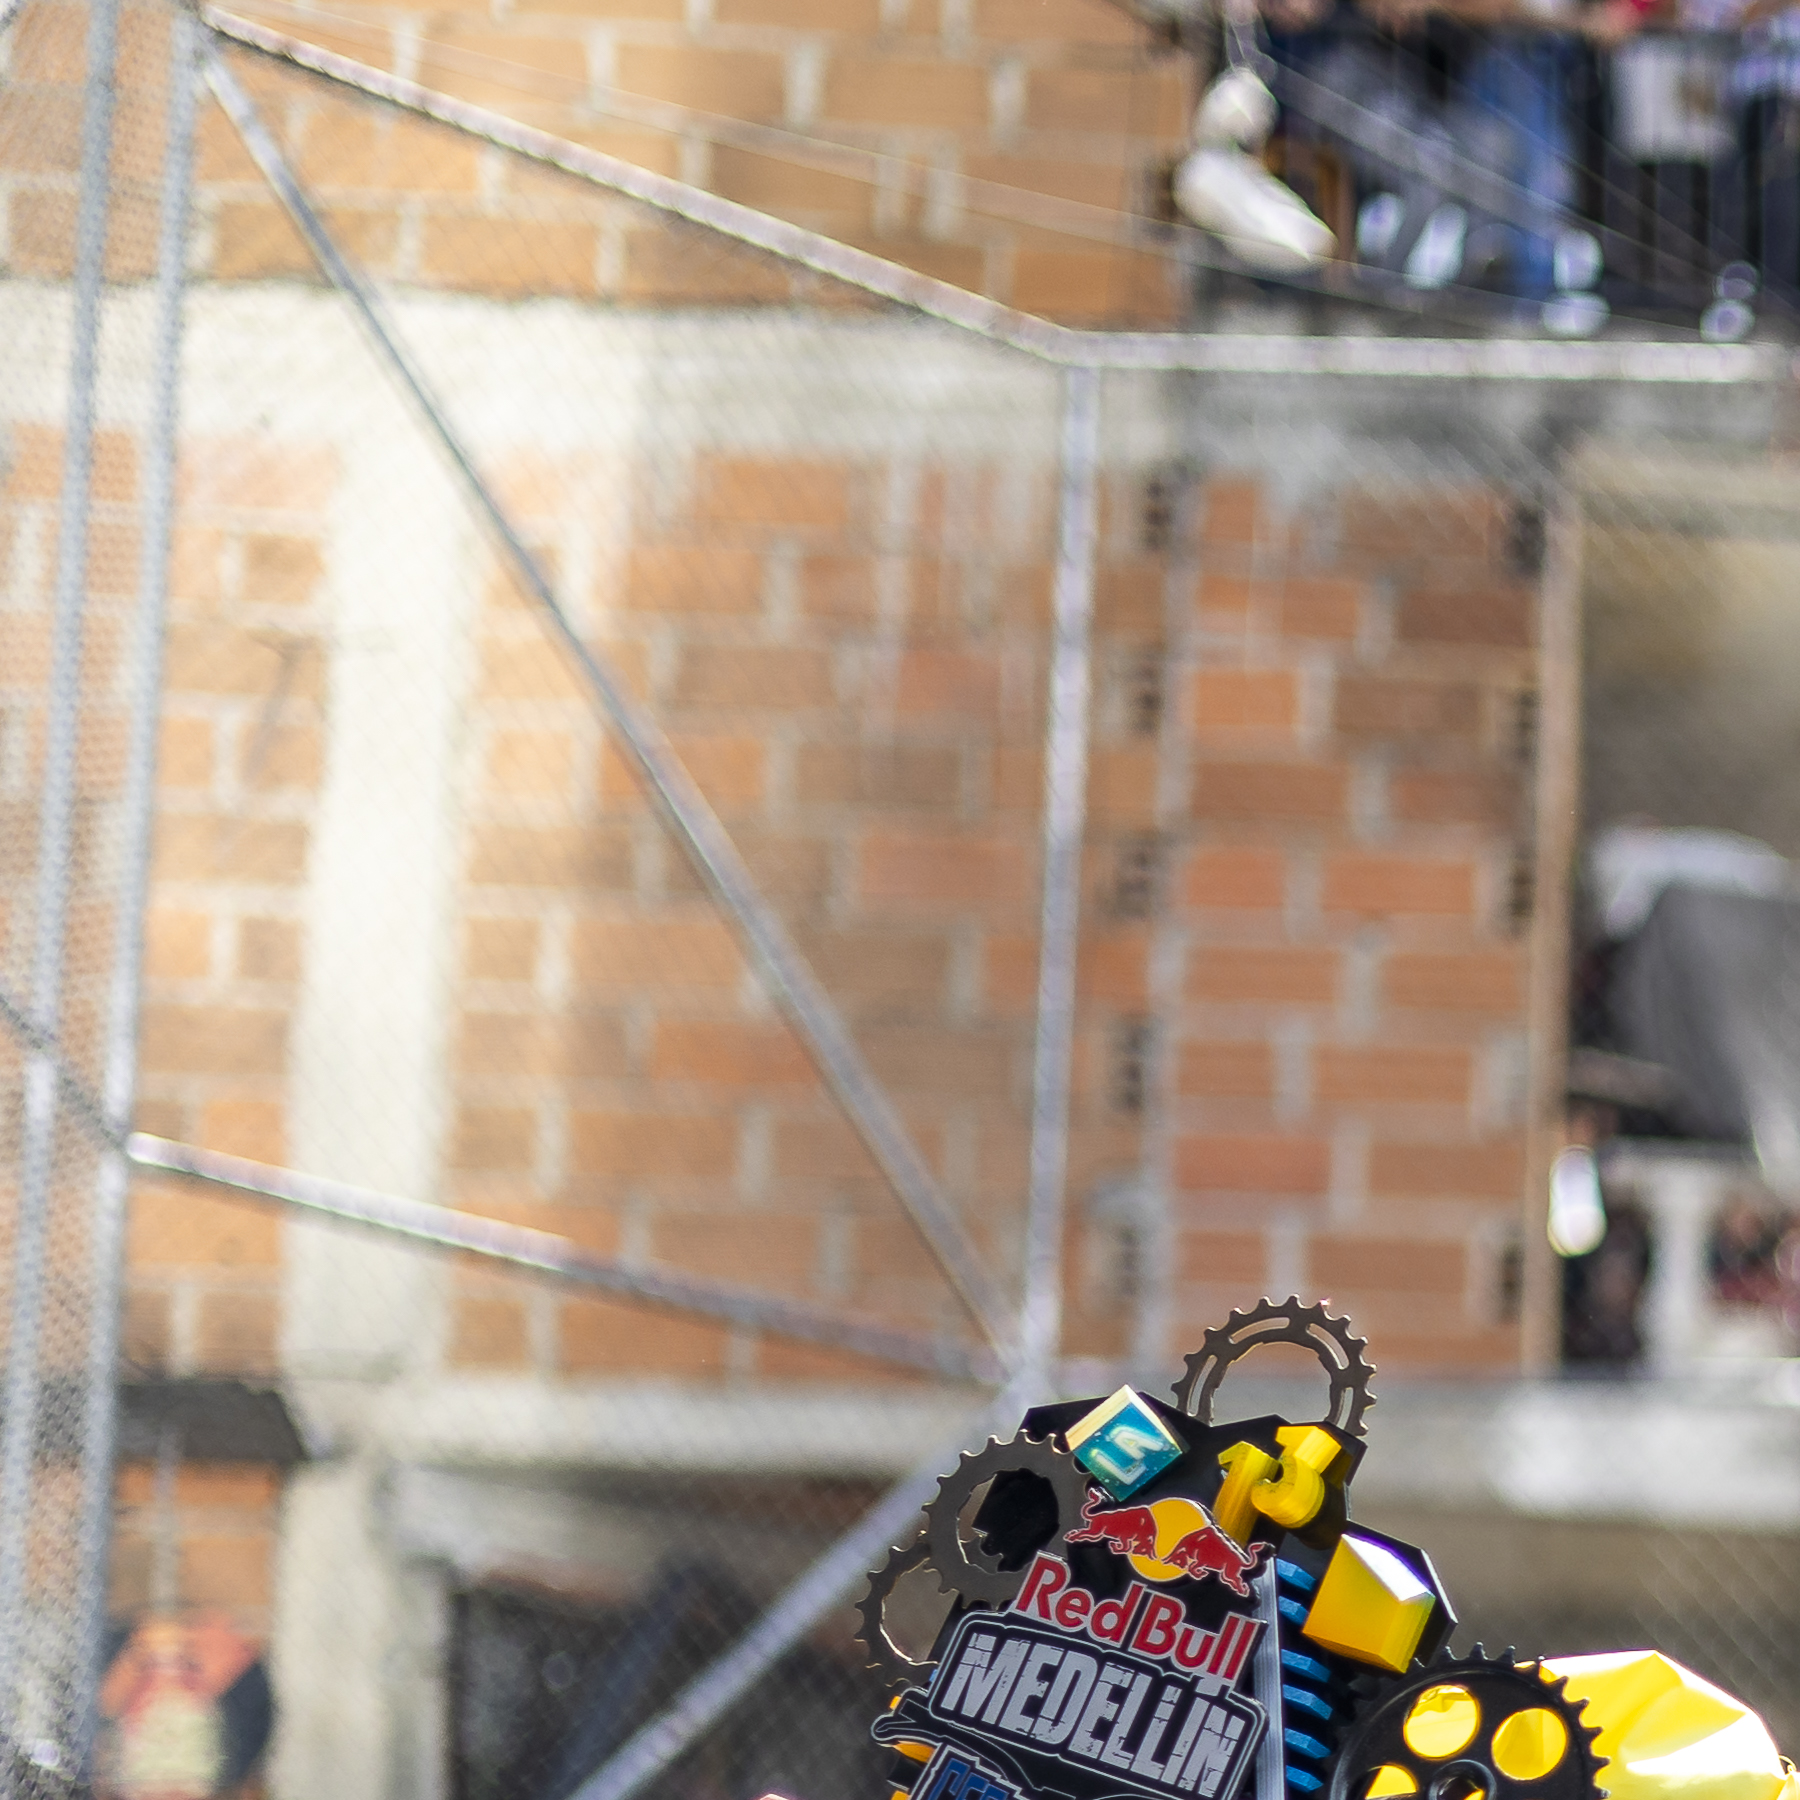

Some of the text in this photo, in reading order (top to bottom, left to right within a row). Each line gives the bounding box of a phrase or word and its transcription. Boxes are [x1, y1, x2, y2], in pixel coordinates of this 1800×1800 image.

[1091, 1424, 1165, 1486] LA
[1015, 1557, 1260, 1680] Red Bull
